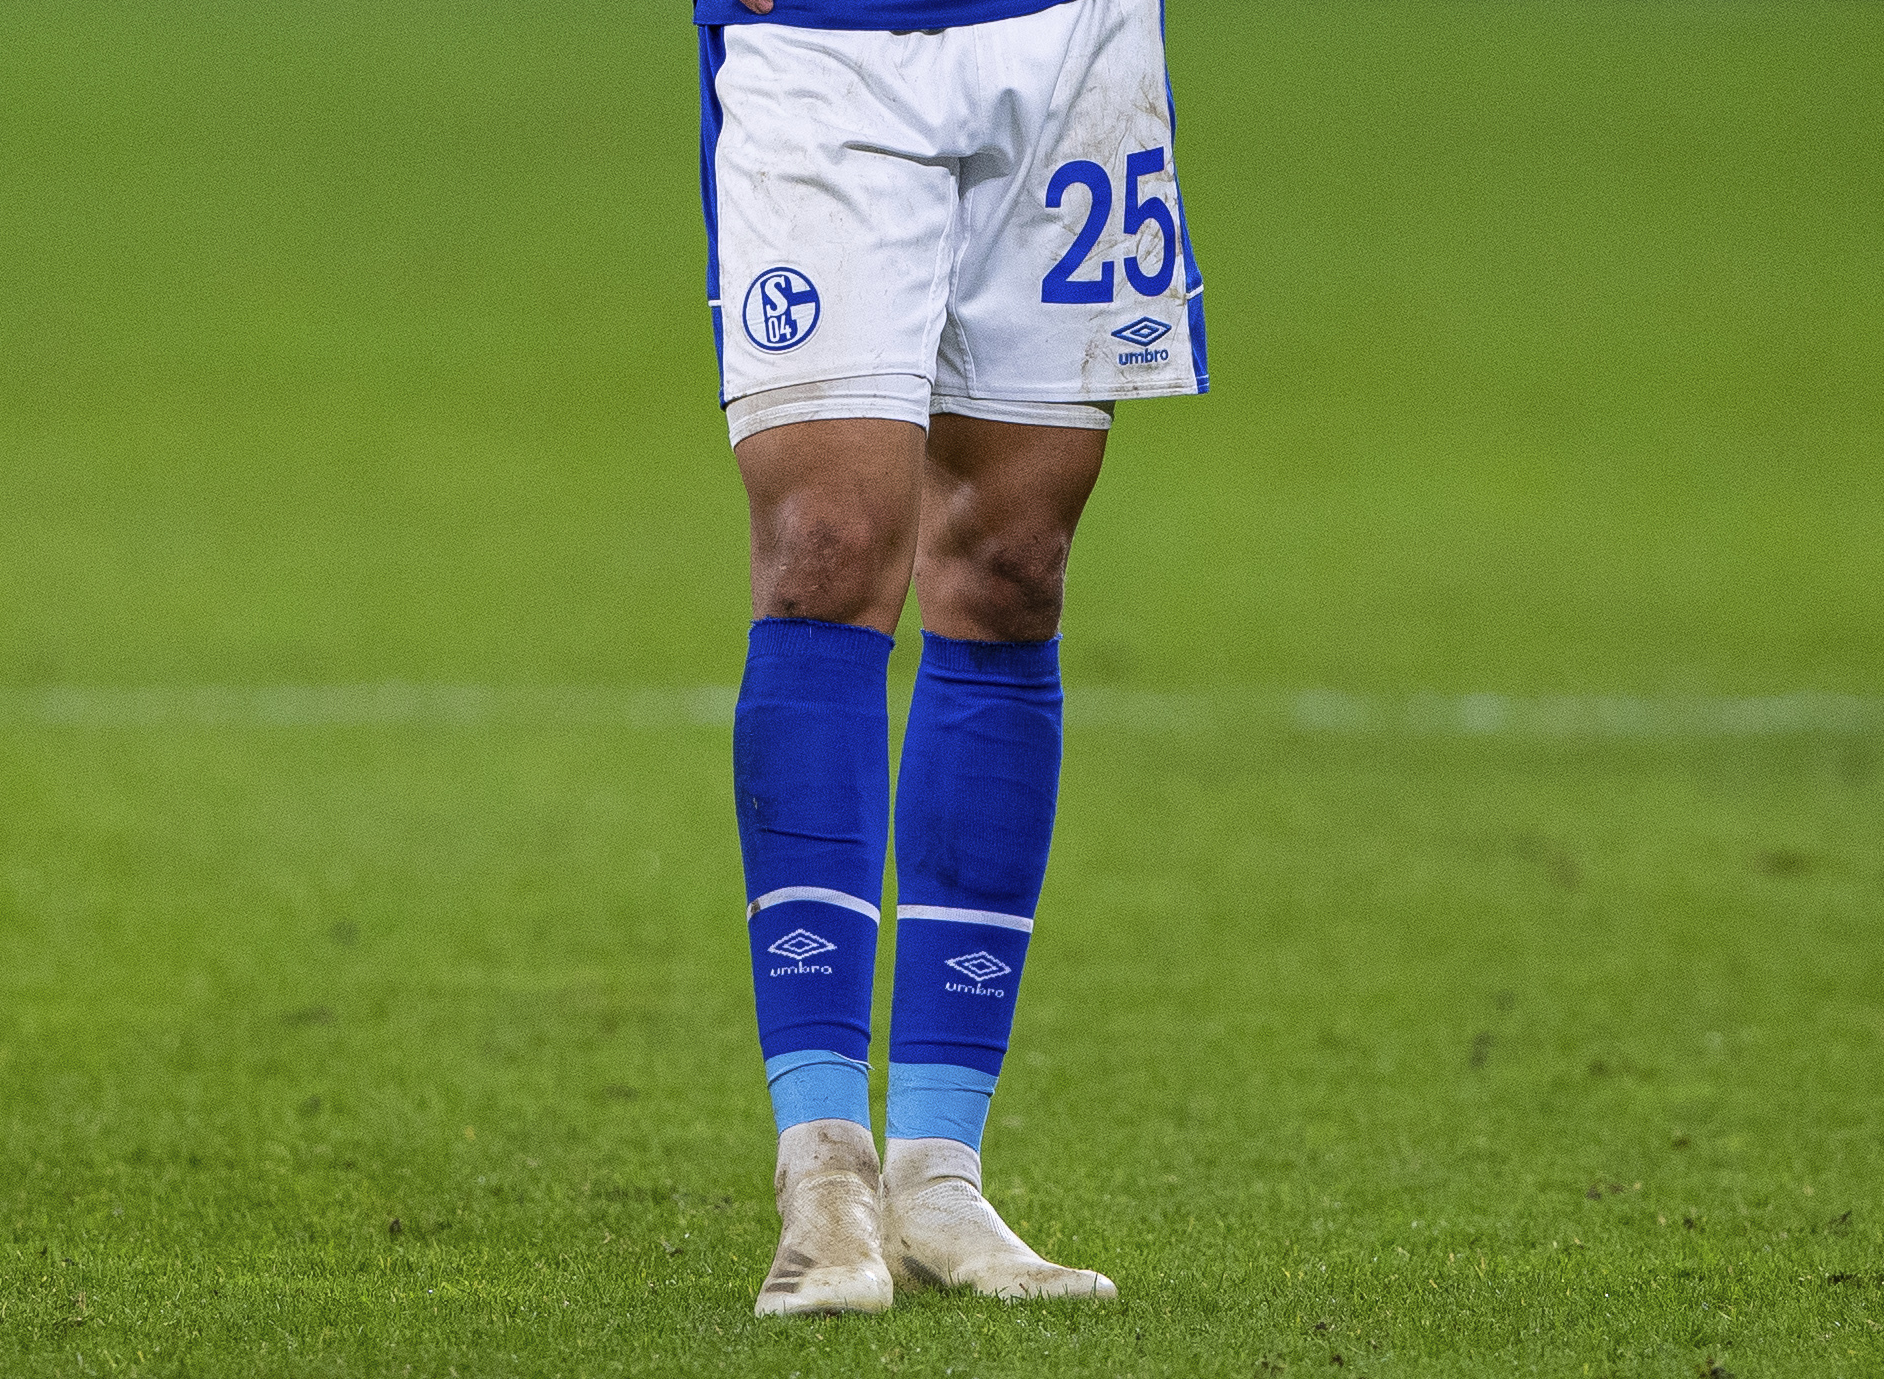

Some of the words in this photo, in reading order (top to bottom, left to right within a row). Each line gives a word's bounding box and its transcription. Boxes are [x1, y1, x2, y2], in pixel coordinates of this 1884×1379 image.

[1041, 146, 1176, 305] 25
[767, 314, 793, 342] 04
[1118, 347, 1170, 366] umbro
[944, 980, 1005, 999] umbro
